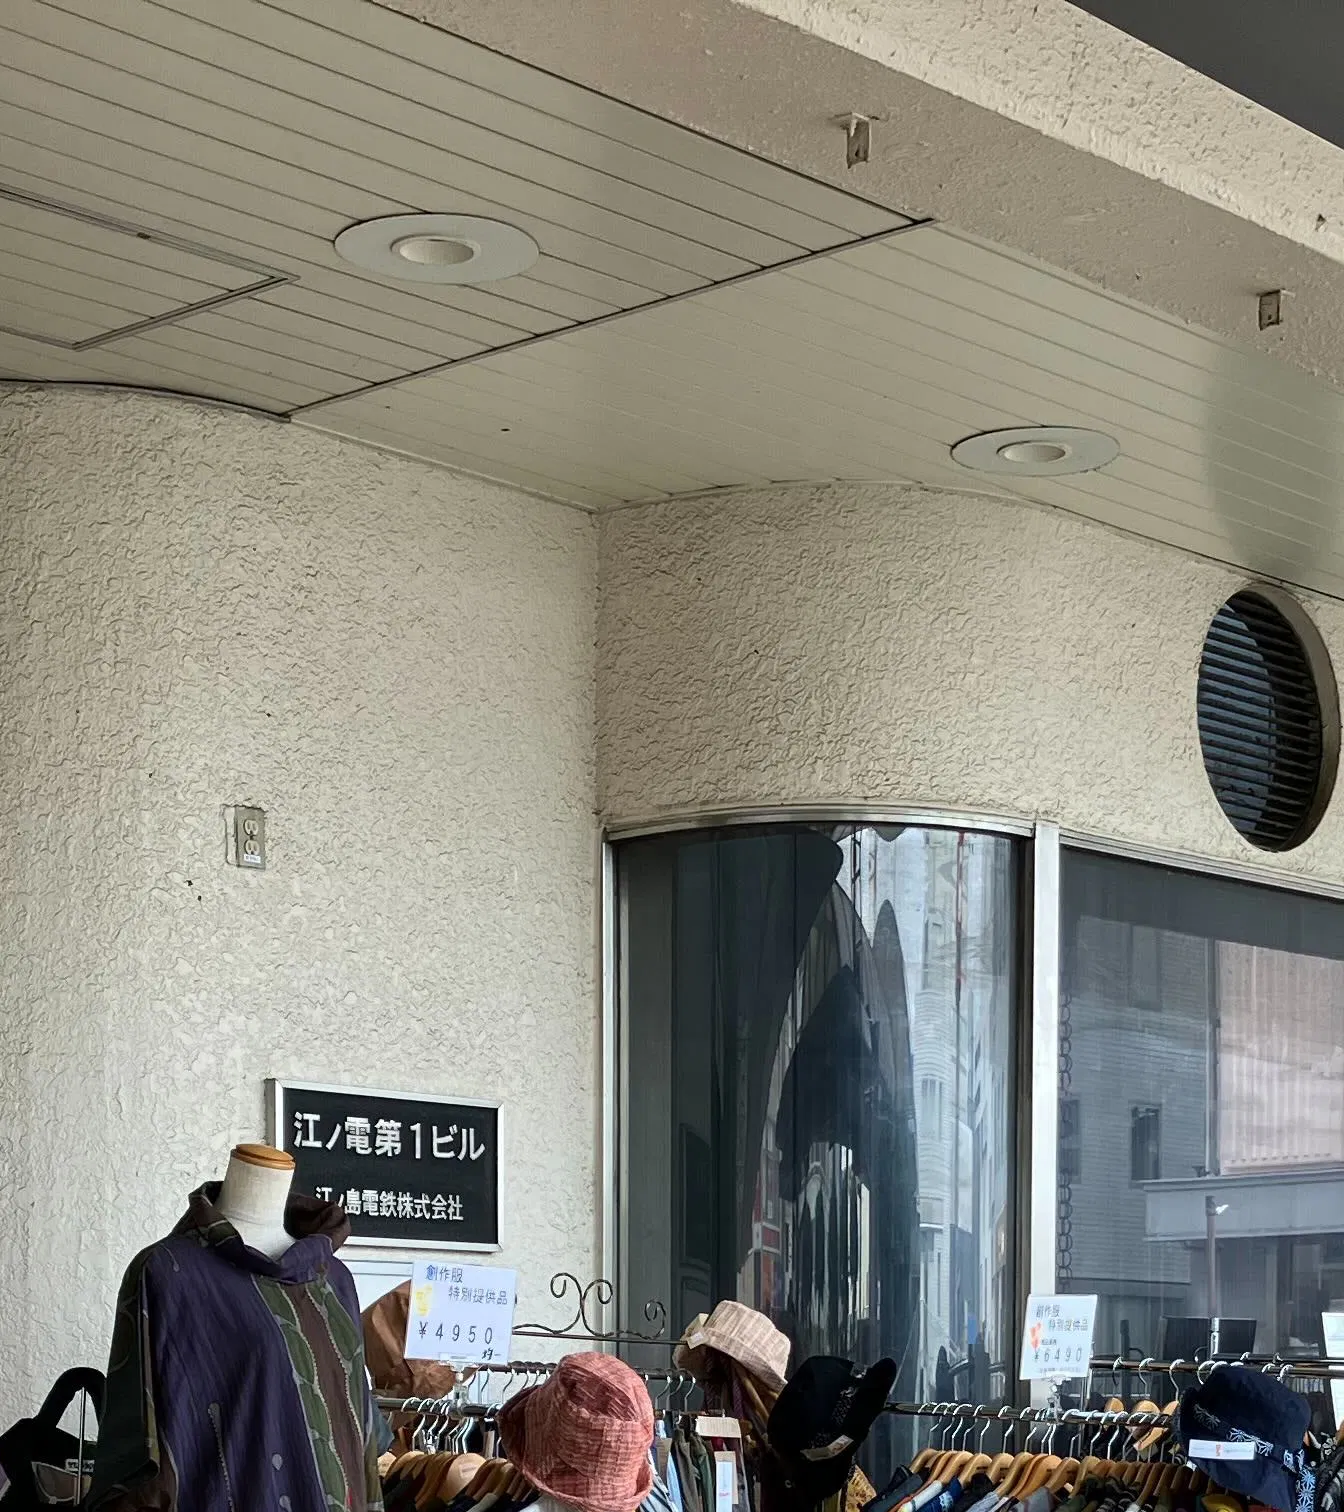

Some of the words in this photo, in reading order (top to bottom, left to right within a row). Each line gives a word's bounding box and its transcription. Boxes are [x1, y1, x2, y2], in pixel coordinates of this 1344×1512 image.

[293, 1111, 486, 1161] 江ノ電第1ビル
[426, 1264, 463, 1283] 創作服
[448, 1285, 508, 1305] 特別提供品
